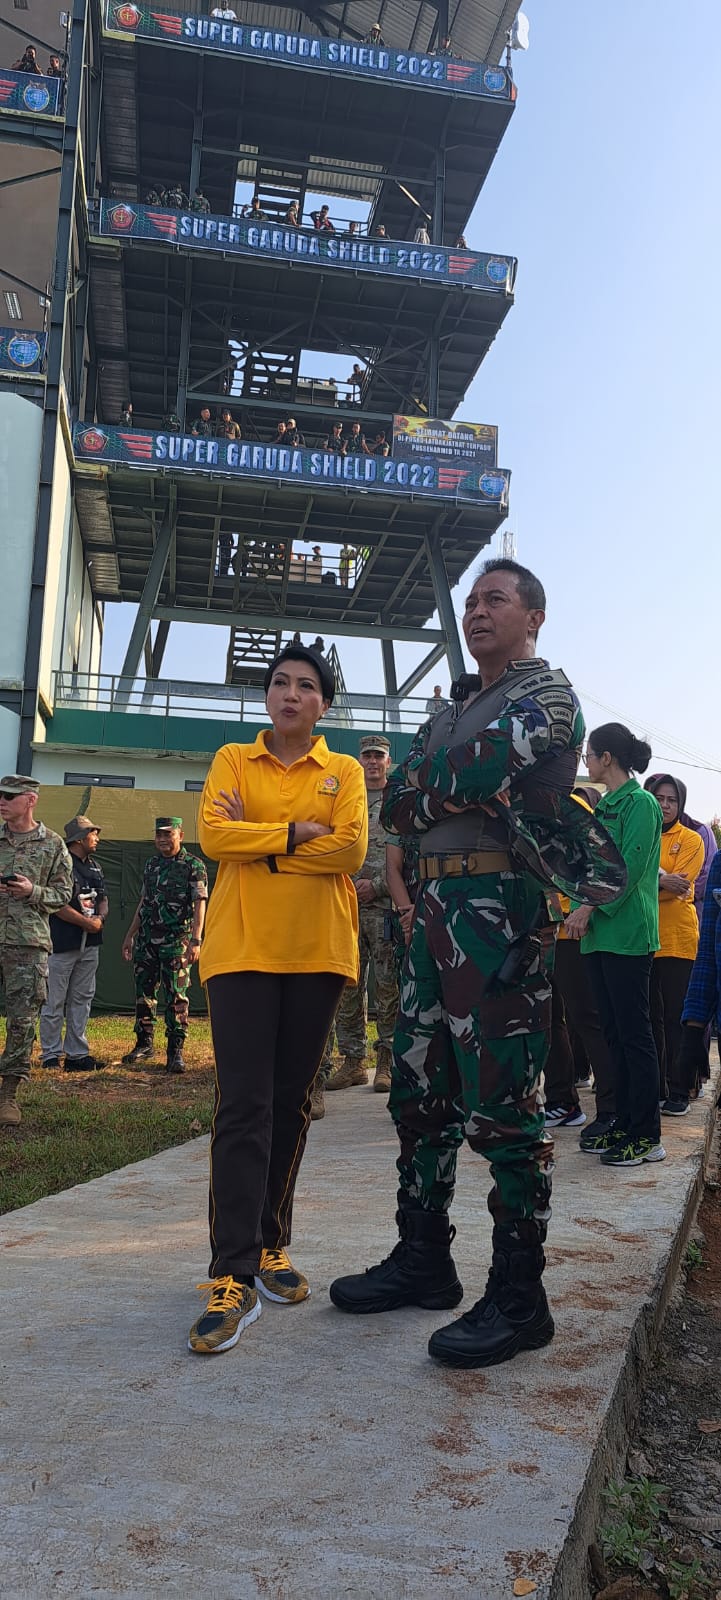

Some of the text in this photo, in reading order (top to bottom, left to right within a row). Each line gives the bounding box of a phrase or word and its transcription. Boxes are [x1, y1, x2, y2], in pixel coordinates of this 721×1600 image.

[184, 17, 444, 80] SUPER GARUDA SHIELD 2022
[180, 216, 446, 273] SUPER GARUDA SHIELD 2022
[155, 435, 435, 488] SUPER GARUDA SHIELD 2022
[520, 675, 554, 690] TNI AD
